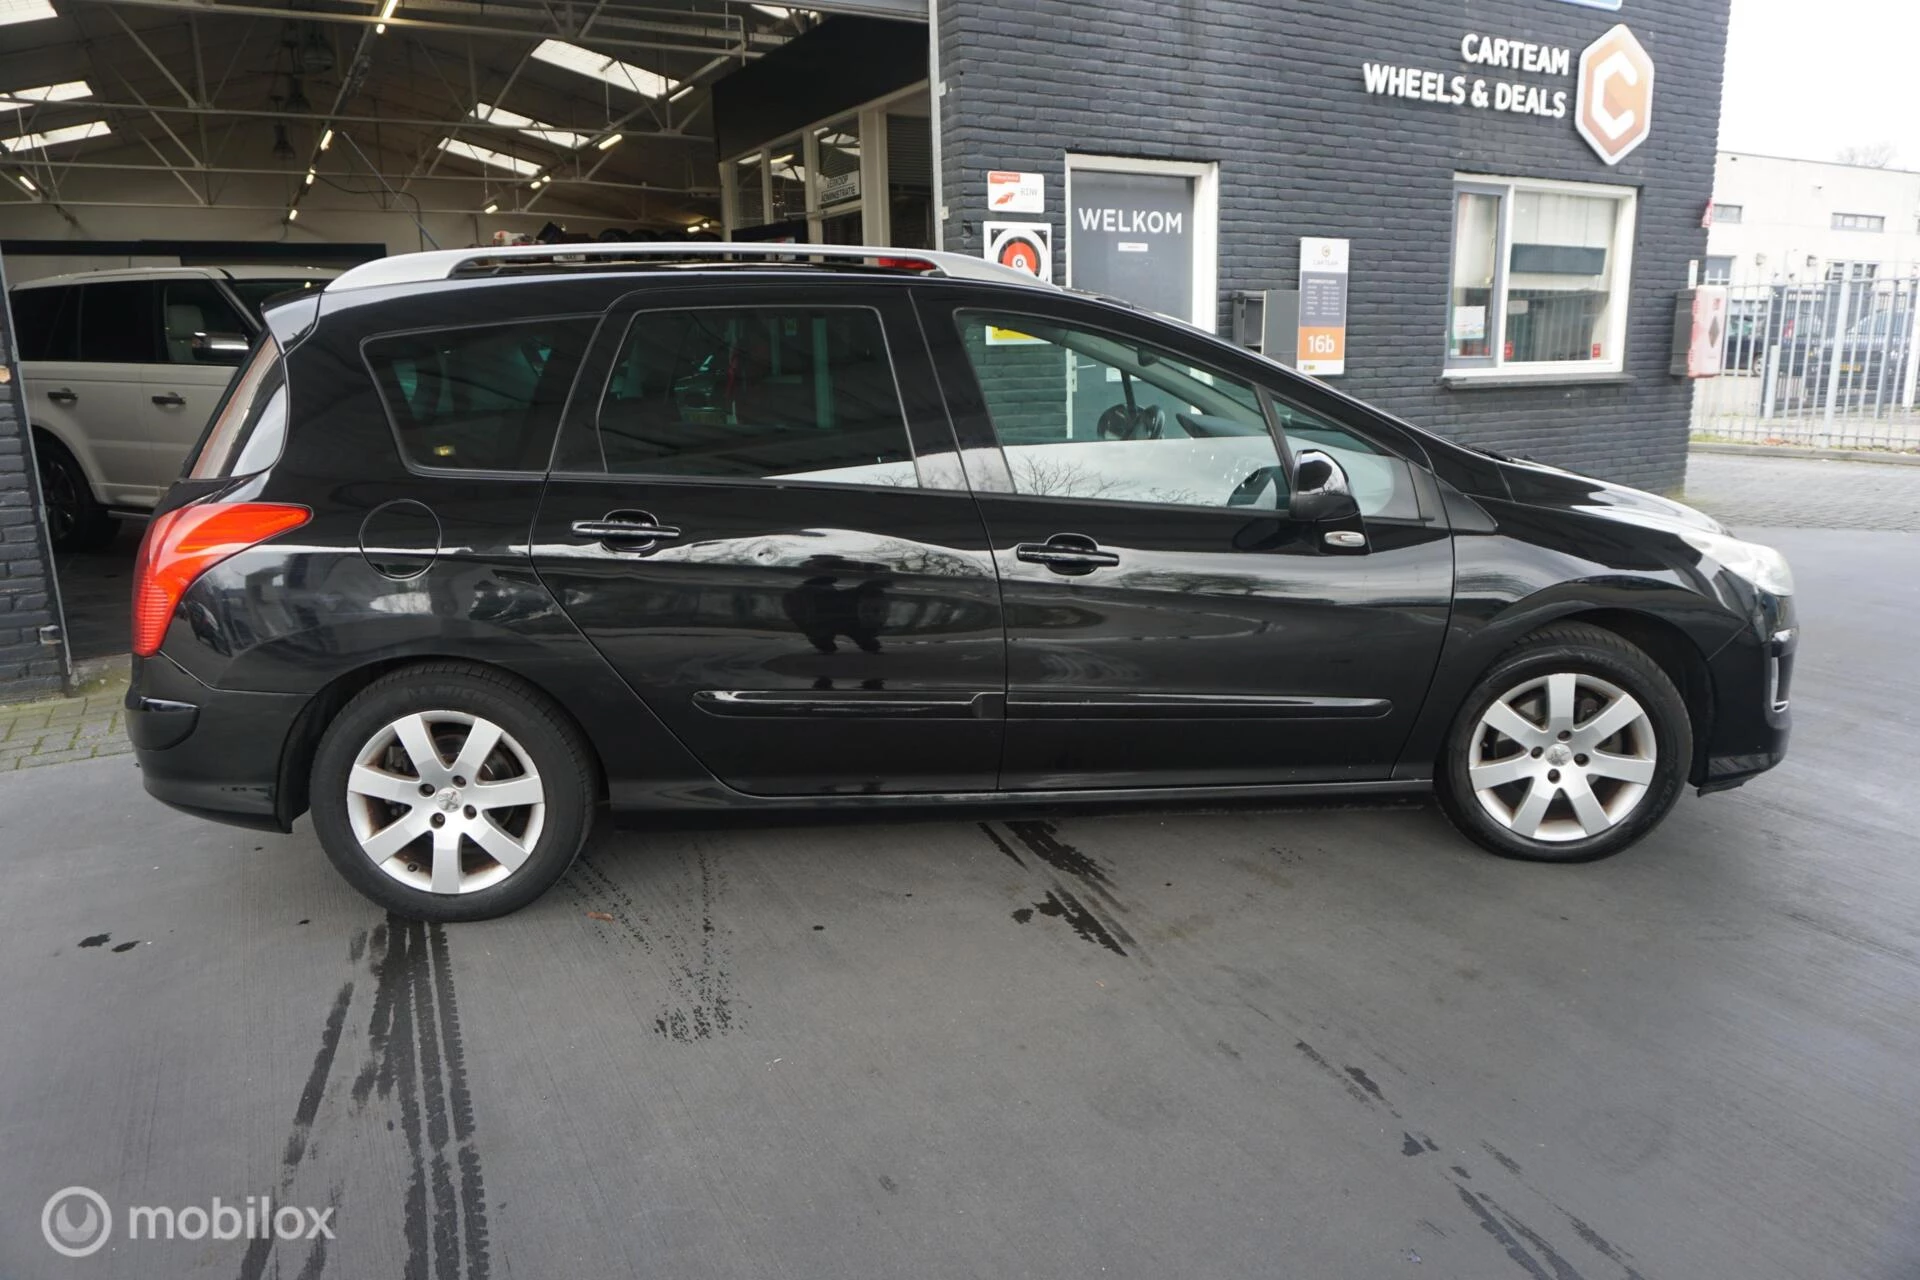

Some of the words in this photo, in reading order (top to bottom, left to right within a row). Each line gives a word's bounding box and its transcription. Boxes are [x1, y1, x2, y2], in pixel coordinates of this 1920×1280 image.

[1461, 34, 1570, 76] CARTEAM
[1362, 62, 1466, 105] WHEELS
[1470, 79, 1489, 108] &
[1495, 82, 1567, 118] DEALS
[1078, 207, 1183, 234] WELKOM
[1307, 334, 1335, 354] 16b
